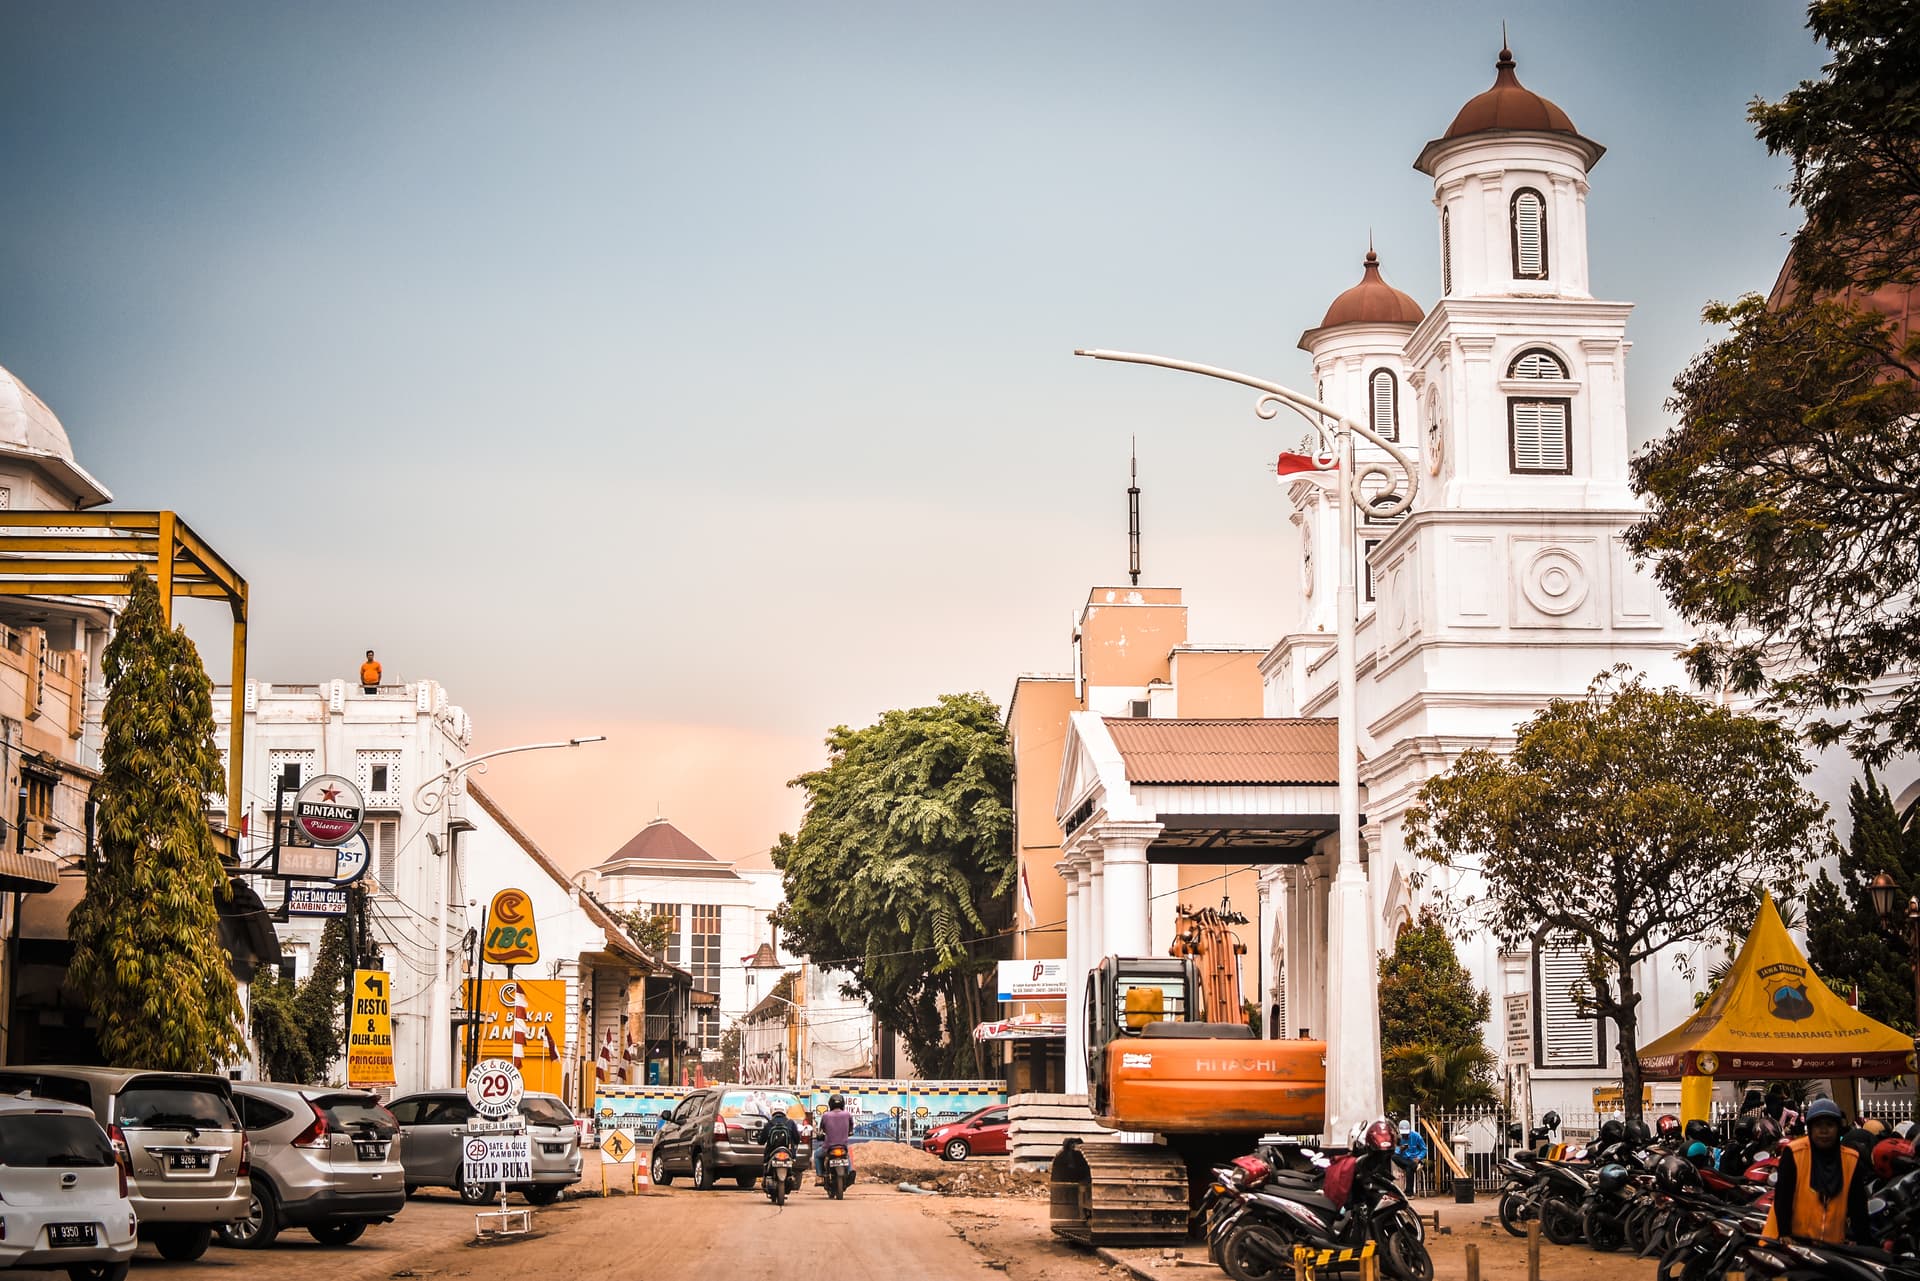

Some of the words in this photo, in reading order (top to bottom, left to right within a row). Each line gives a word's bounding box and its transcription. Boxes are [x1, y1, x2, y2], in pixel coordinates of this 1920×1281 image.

[302, 804, 352, 819] BINTANG
[310, 820, 343, 830] Pilsener
[285, 853, 312, 868] SATE
[338, 851, 362, 863] OST
[291, 890, 309, 901] SATE
[310, 891, 325, 902] DAN
[326, 892, 346, 902] GULE
[290, 901, 327, 912] KAMBING
[487, 926, 533, 949] IBC
[357, 998, 387, 1016] RESTO
[506, 1010, 553, 1022] BKAR
[367, 1018, 375, 1033] &
[352, 1033, 391, 1046] OLEH-OLEH
[1729, 1028, 1770, 1040] POLSEK
[1773, 1029, 1833, 1039] SEMARANG
[1836, 1027, 1870, 1037] UTARA
[349, 1055, 393, 1065] PRINGSEWU
[469, 1061, 487, 1085] SATE
[490, 1060, 496, 1069] &
[499, 1060, 520, 1080] GULE
[482, 1074, 509, 1098] 29
[475, 1098, 517, 1115] KAMBING
[469, 1144, 485, 1157] 29
[489, 1142, 503, 1150] SATE
[511, 1142, 527, 1150] GULE
[170, 1154, 175, 1165] H
[490, 1150, 526, 1158] KAMBING
[465, 1162, 498, 1179] TETAP
[502, 1162, 530, 1178] BUKA
[51, 1226, 57, 1238] H
[61, 1226, 79, 1238] 9350
